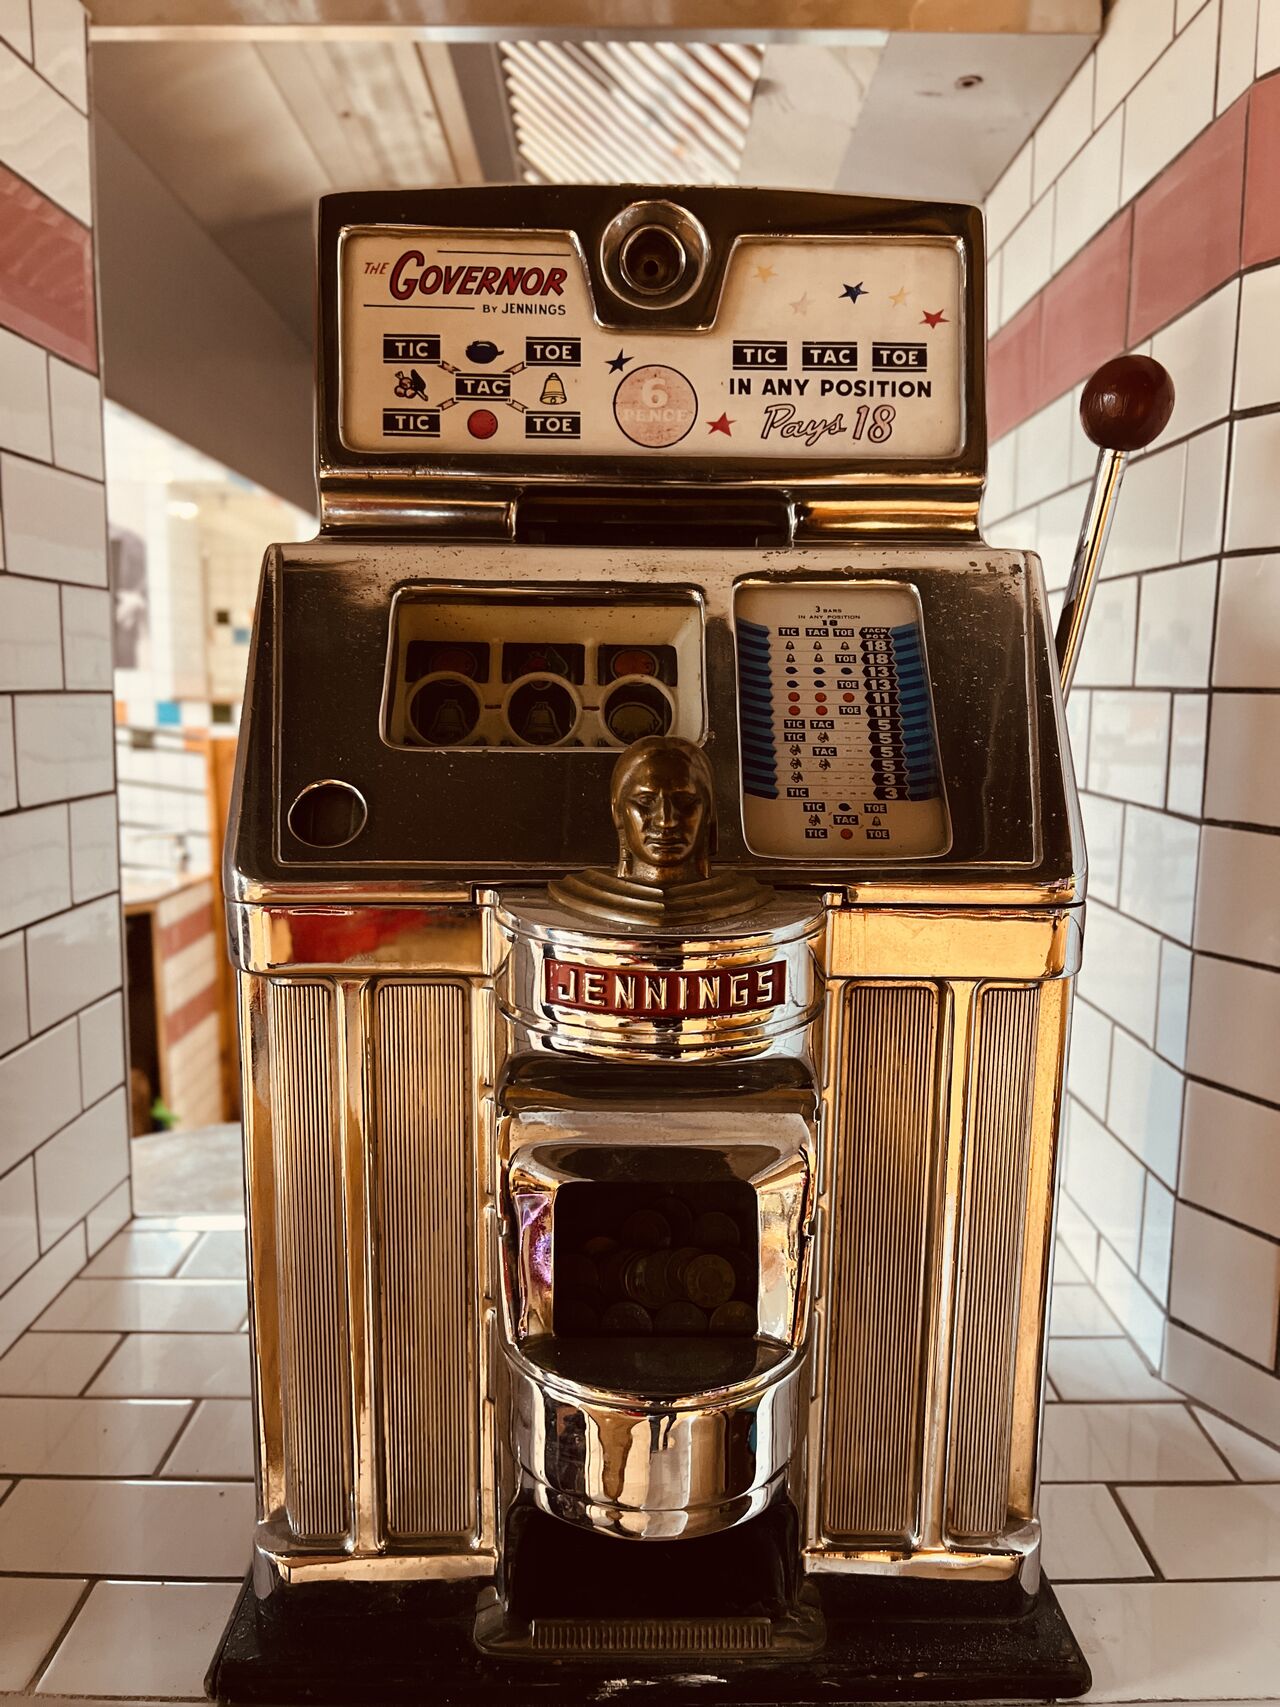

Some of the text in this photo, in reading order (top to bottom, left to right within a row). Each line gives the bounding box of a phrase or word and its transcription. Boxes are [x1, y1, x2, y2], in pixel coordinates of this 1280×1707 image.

[364, 250, 568, 301] THE GOVERNOR
[482, 303, 566, 315] BY JENNINGS
[395, 342, 429, 357] TIC
[533, 345, 572, 360] TOE
[742, 348, 919, 365] TIC TAC TOE
[463, 379, 508, 394] TAC
[729, 378, 932, 398] IN ANY POSITION
[641, 378, 669, 408] 6
[622, 409, 689, 423] PENCE
[395, 415, 430, 430] TIC
[533, 417, 572, 432] TOE
[760, 403, 896, 446] Pays 18
[866, 640, 887, 651] 18
[867, 653, 889, 664] 18
[868, 667, 890, 677] 13
[869, 680, 891, 690] 13
[873, 692, 889, 703] 11
[874, 706, 891, 717] 11
[878, 719, 891, 730] 5
[879, 733, 893, 744] 5
[880, 747, 894, 758] 5
[881, 760, 895, 771] 5
[883, 774, 896, 785] 3
[885, 787, 898, 799] 3
[805, 803, 823, 811] TIC
[866, 804, 885, 812] TOE
[835, 816, 857, 824] TAC
[807, 829, 825, 837] TIC
[868, 830, 888, 838] TOE
[557, 969, 773, 1010] JENNINGS
